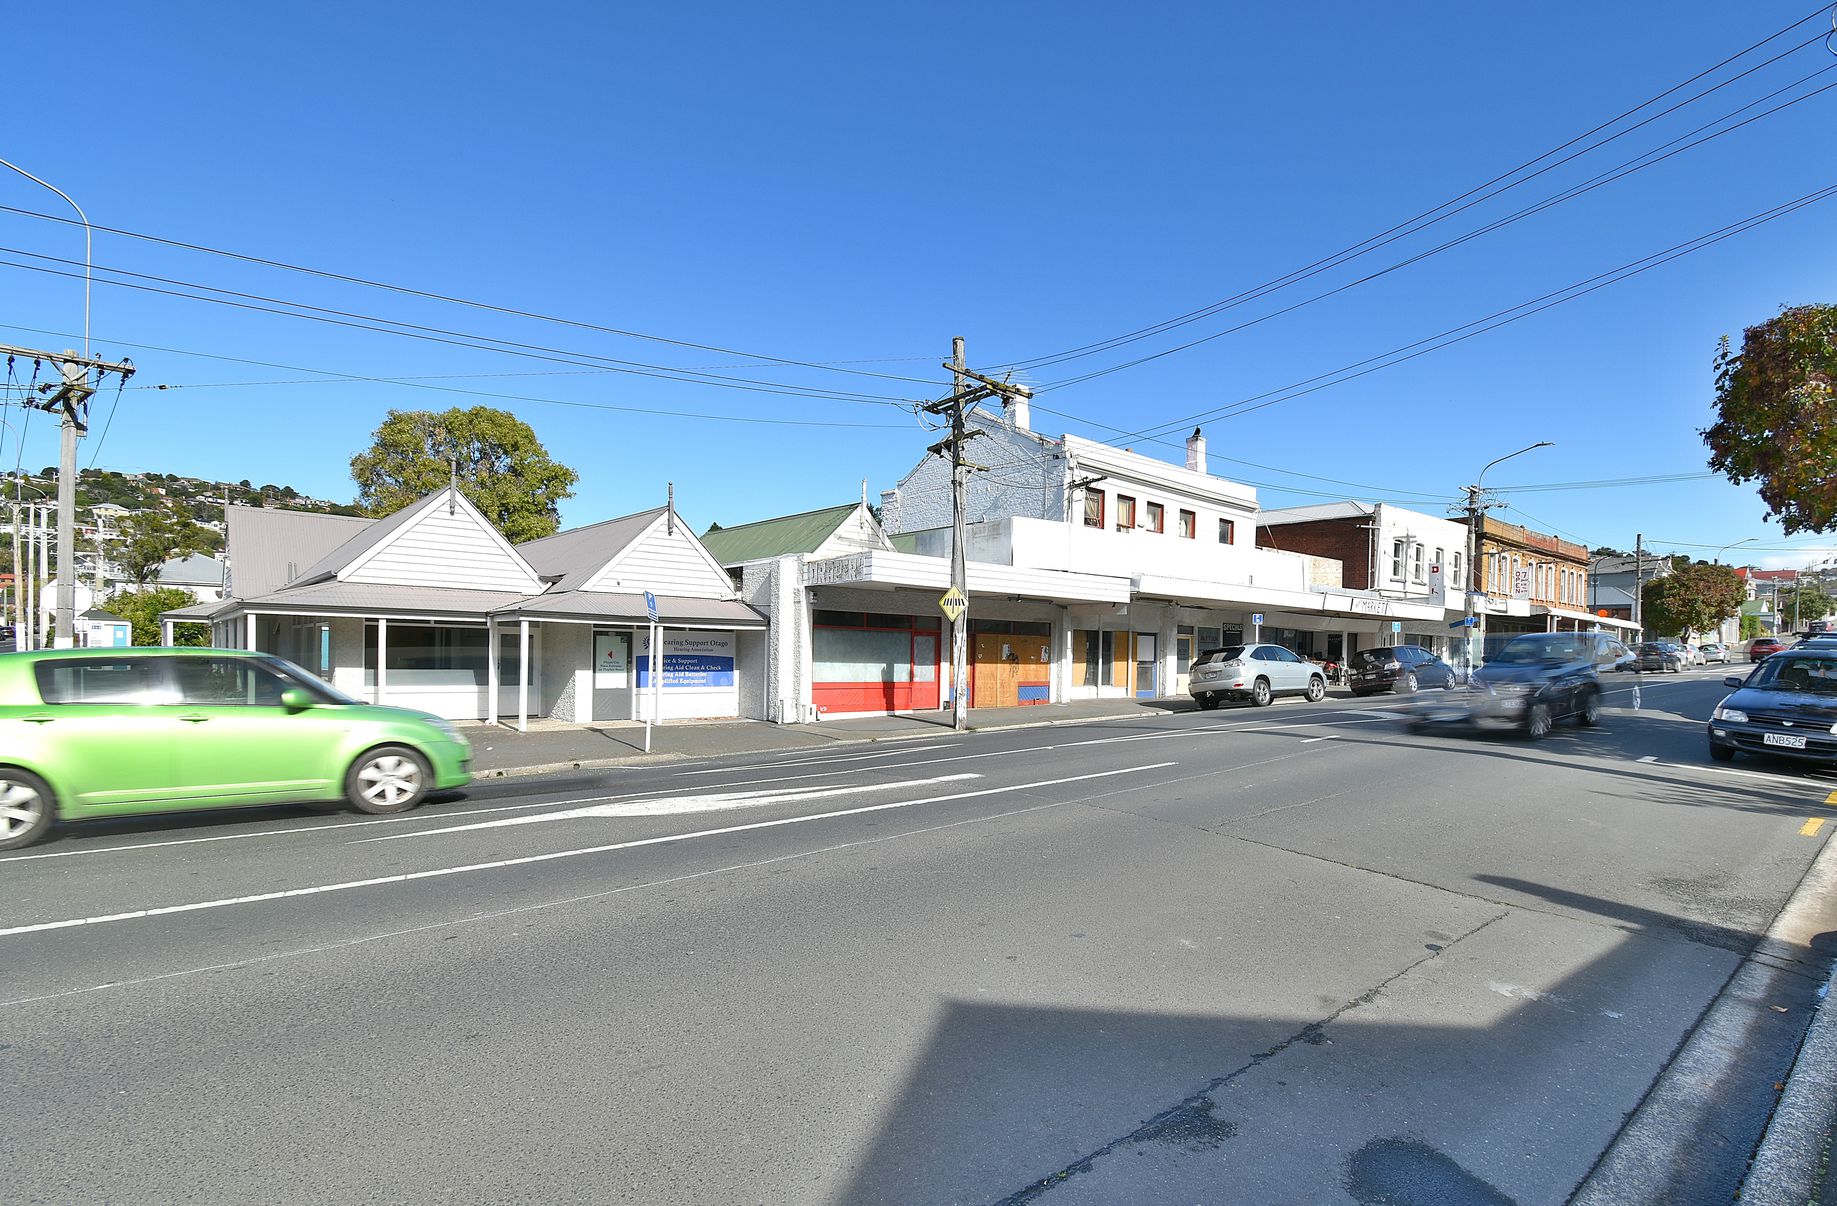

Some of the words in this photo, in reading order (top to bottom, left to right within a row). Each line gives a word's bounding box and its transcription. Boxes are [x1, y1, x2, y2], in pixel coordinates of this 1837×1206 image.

[1361, 600, 1386, 614] MARKET
[664, 639, 684, 647] earing
[684, 639, 709, 648] Support
[709, 639, 728, 648] Otago
[1765, 735, 1804, 747] ANB525
